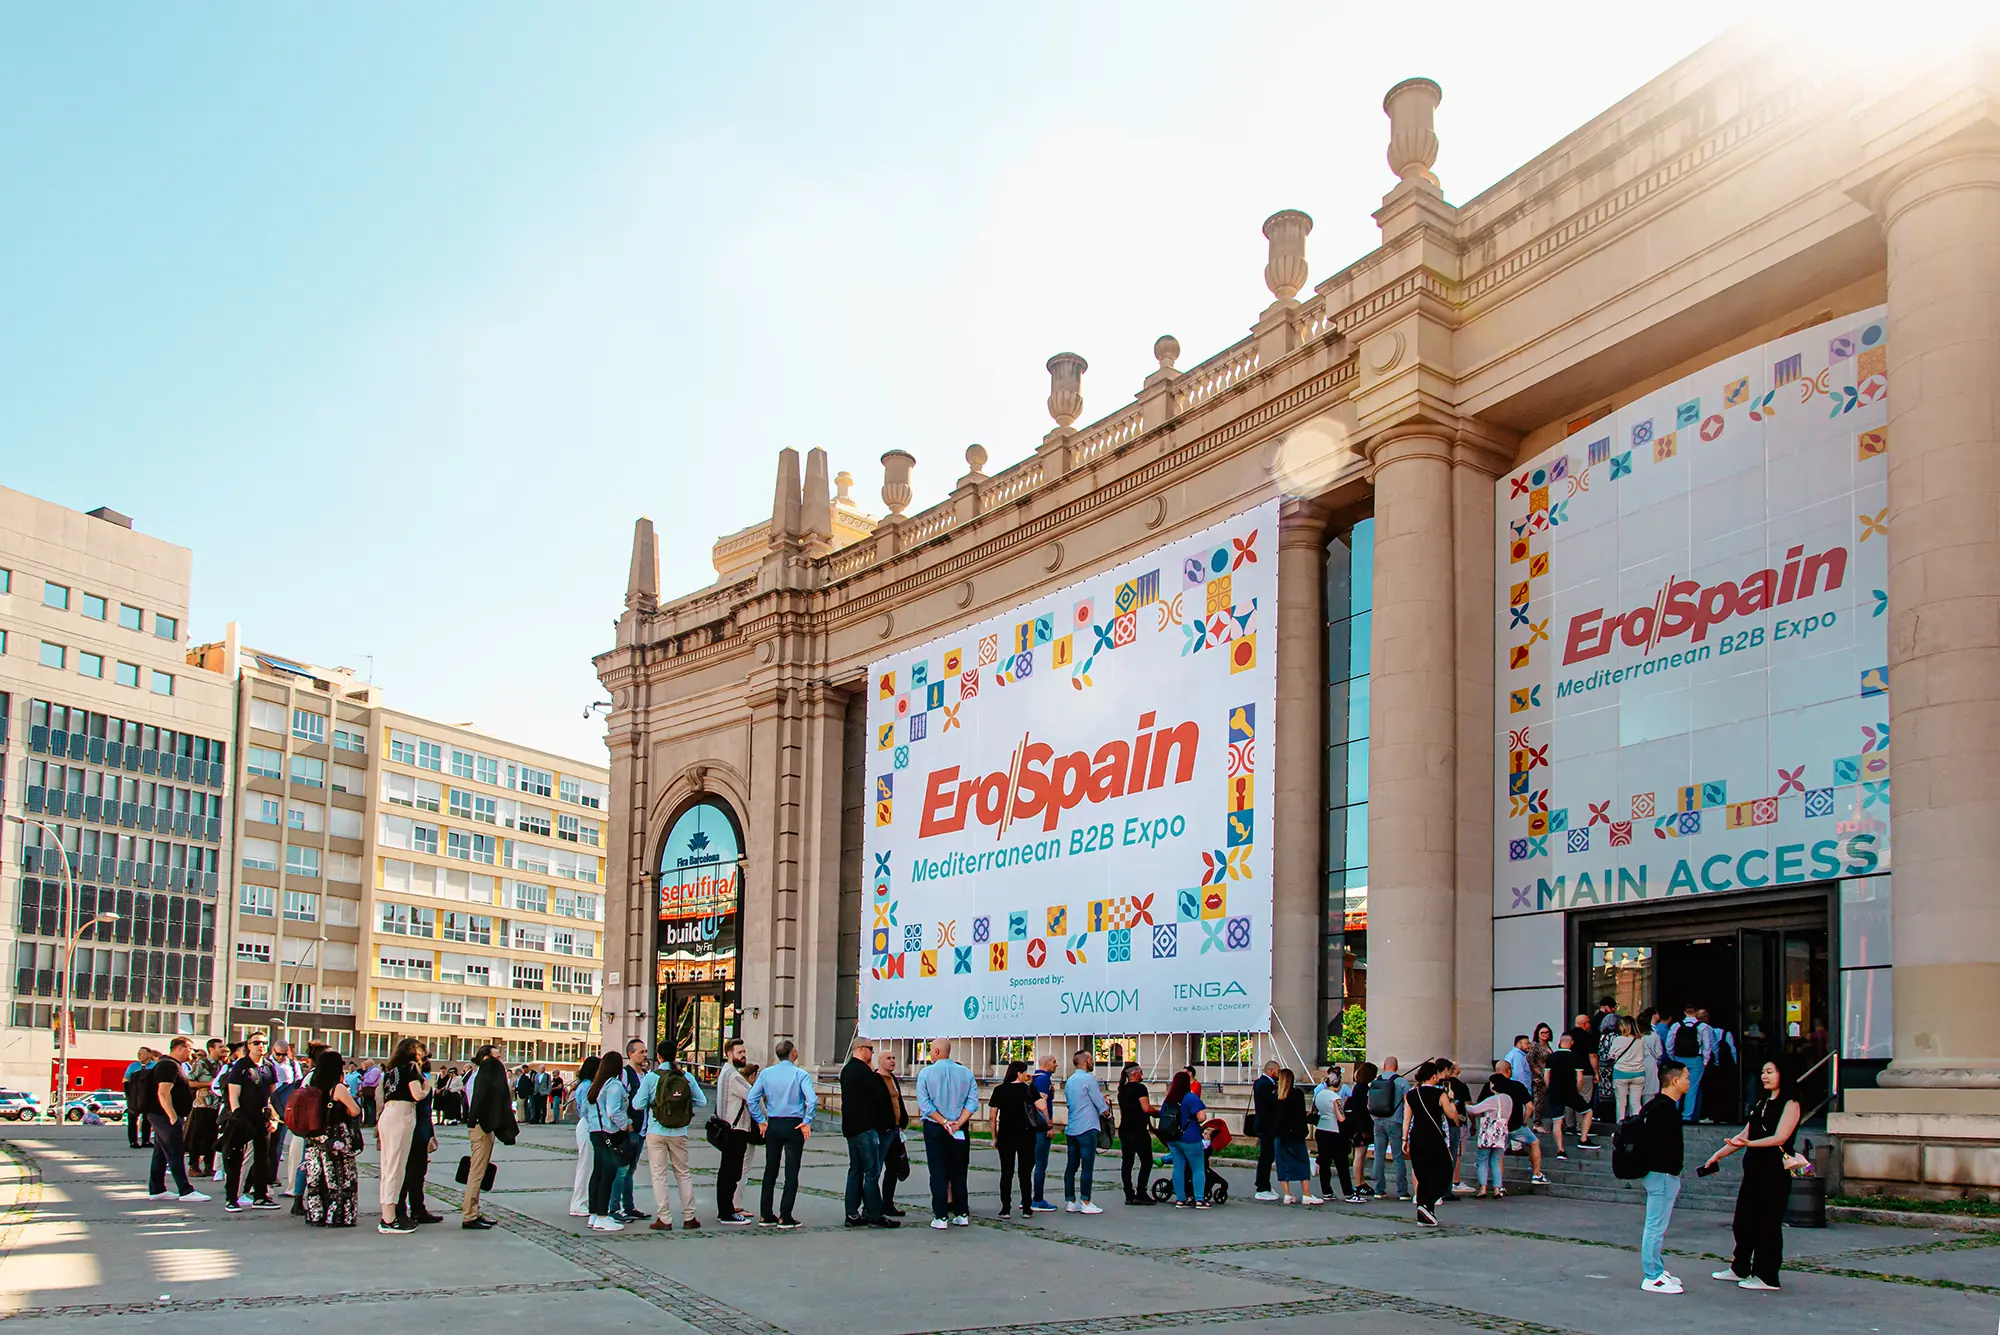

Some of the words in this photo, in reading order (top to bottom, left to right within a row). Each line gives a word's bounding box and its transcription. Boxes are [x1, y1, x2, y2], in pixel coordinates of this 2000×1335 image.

[1556, 645, 1711, 698] Mediterranean
[1719, 627, 1765, 655] B2B
[1773, 611, 1837, 642] Expo
[912, 838, 1060, 882] Mediterranean
[1069, 823, 1114, 855] B2B
[1122, 814, 1185, 848] Expo
[677, 857, 689, 867] Fira
[689, 853, 719, 865] Barcelona
[1537, 864, 1647, 910] MAIN
[1665, 834, 1878, 896] ACCESS
[1009, 974, 1050, 988] Sponsored
[1051, 974, 1064, 985] by:
[1173, 980, 1248, 999] TENGA
[871, 1000, 933, 1022] Satisfyer
[981, 994, 1025, 1012] SHUNGA
[1060, 988, 1139, 1014] SVAKOM
